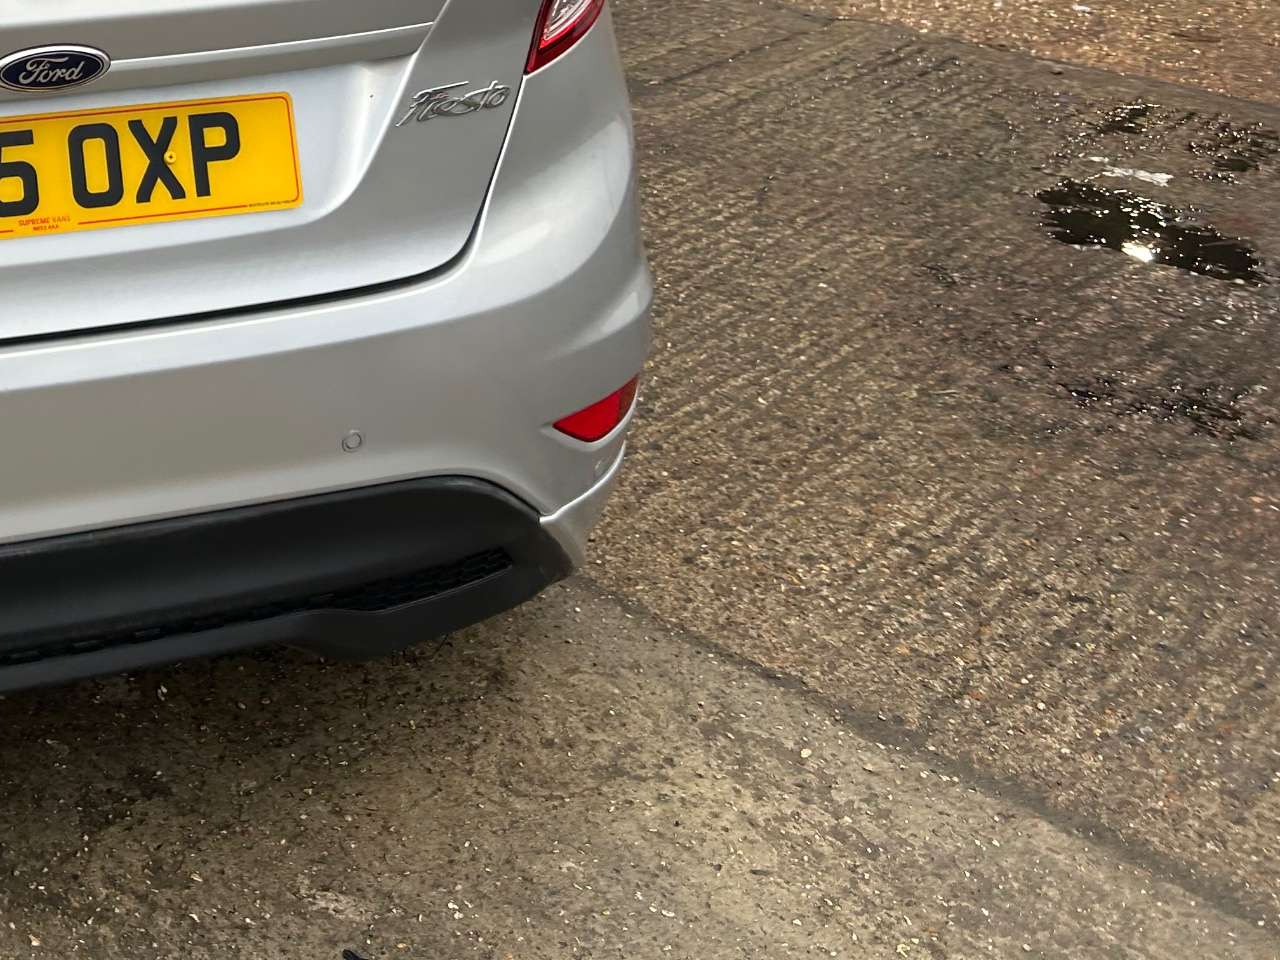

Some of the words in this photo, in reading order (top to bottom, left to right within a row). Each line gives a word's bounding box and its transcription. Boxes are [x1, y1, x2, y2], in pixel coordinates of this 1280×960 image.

[19, 57, 85, 85] Ford
[395, 80, 510, 127] Fiesta
[67, 111, 241, 210] OXP
